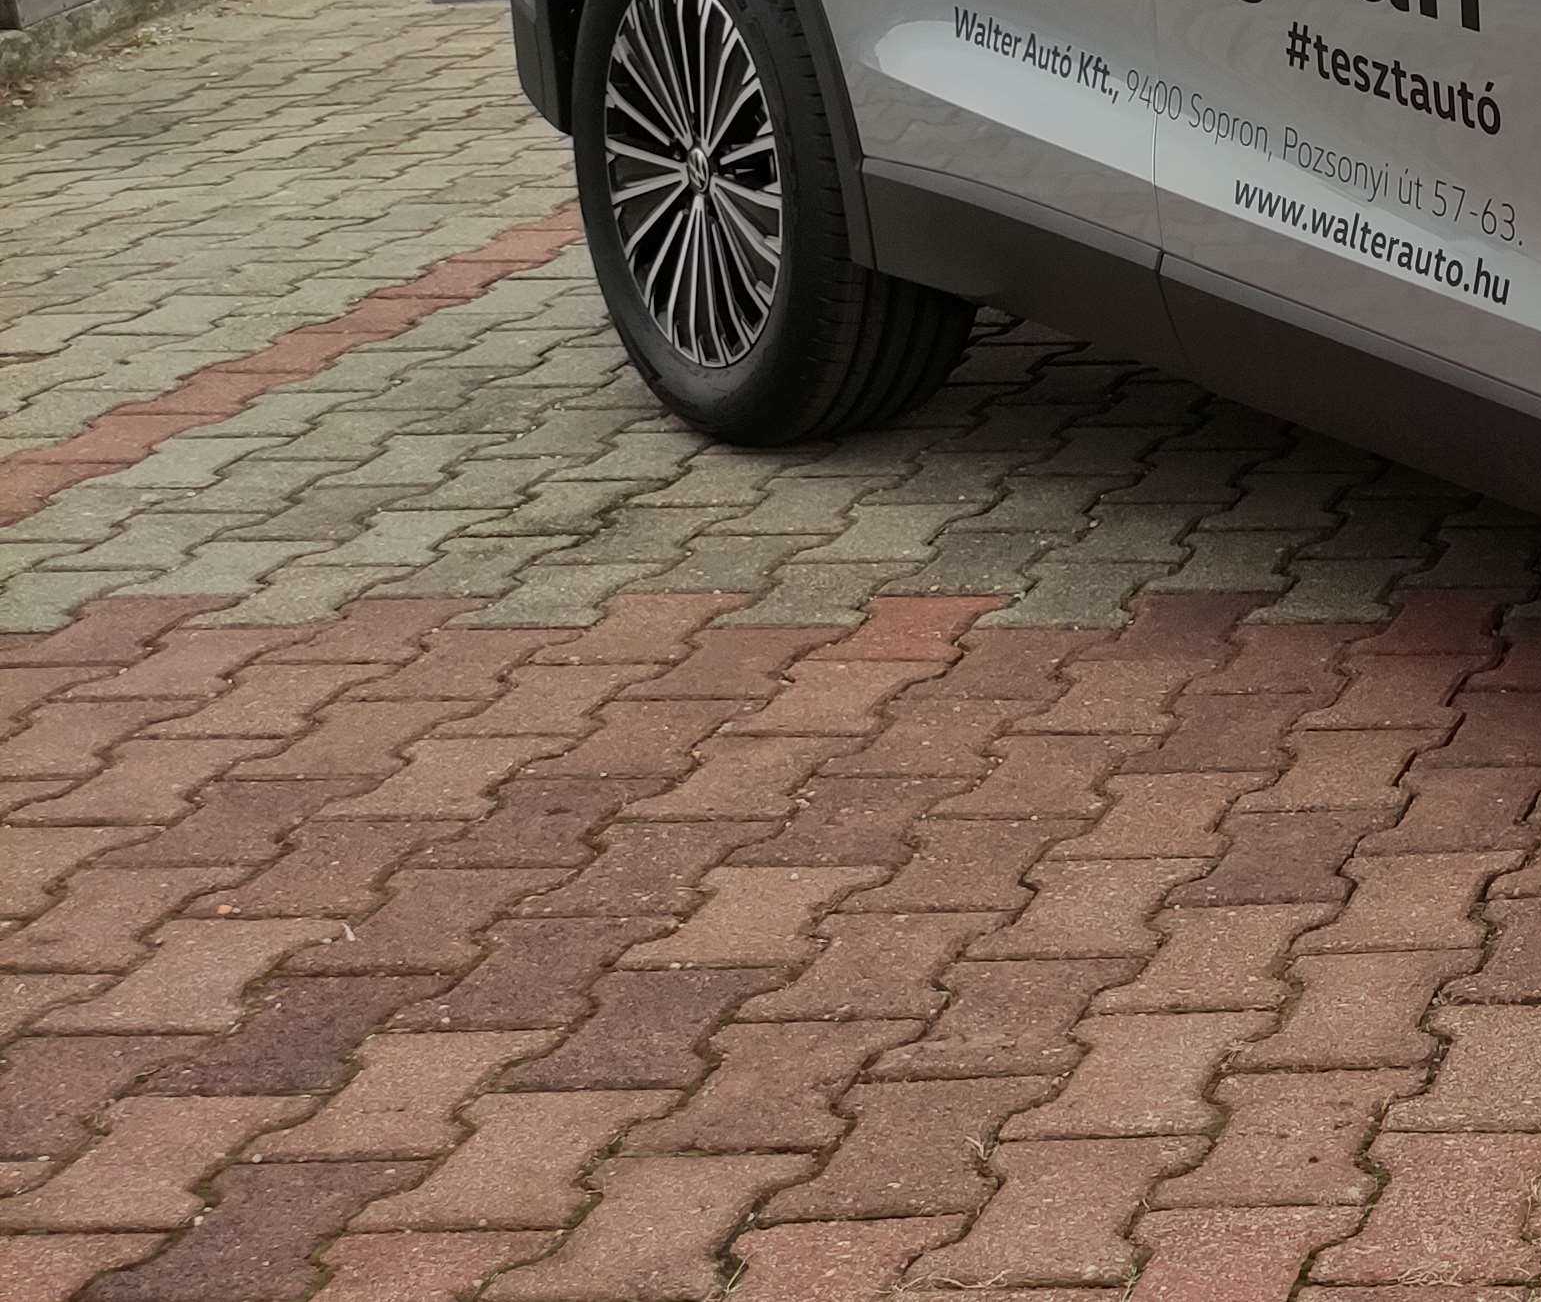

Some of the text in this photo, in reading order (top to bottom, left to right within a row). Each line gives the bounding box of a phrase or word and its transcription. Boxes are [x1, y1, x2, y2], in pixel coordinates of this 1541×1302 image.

[953, 6, 1525, 247] Walter Autó Kft., 9400 Sopron, Pozsonyi út 57-63.
[1286, 21, 1502, 136] #tesztautó
[1234, 179, 1511, 306] www.walterauto.hu
